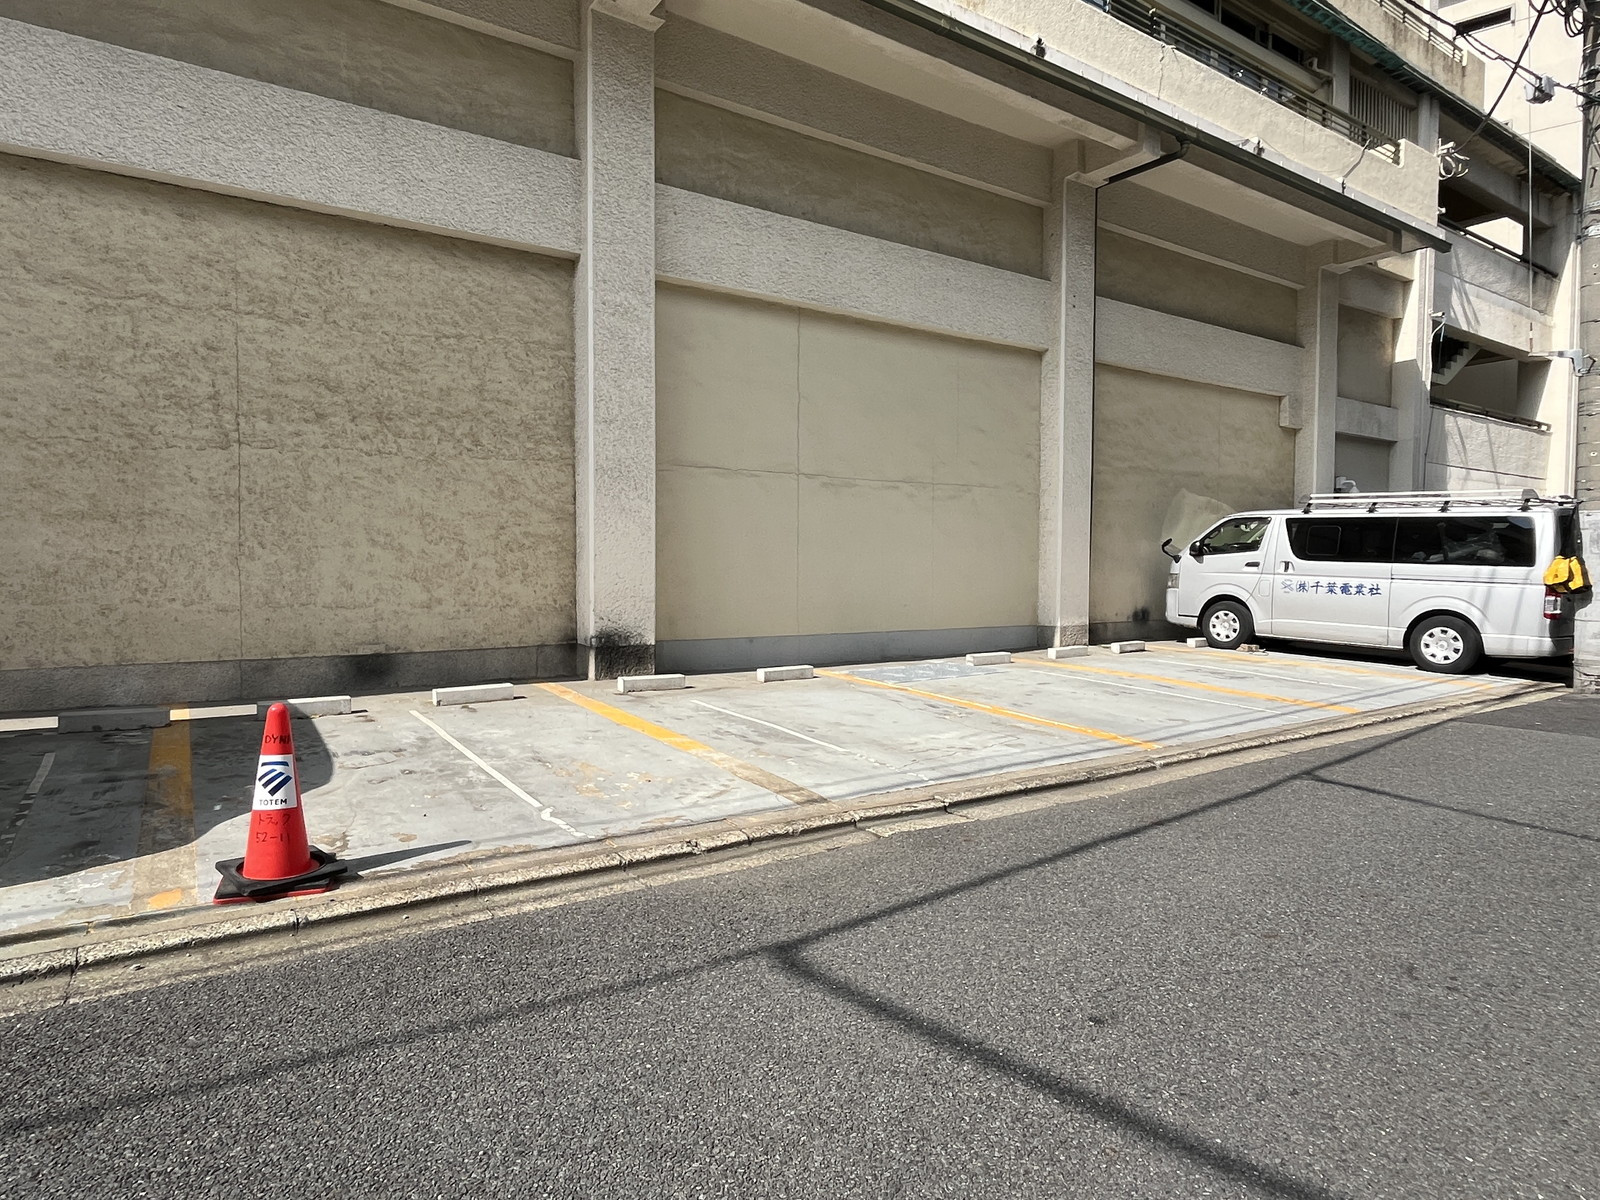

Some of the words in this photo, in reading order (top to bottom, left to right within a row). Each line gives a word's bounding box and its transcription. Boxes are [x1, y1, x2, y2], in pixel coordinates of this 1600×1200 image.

[259, 798, 288, 806] TOTEM
[258, 813, 291, 826] トラック
